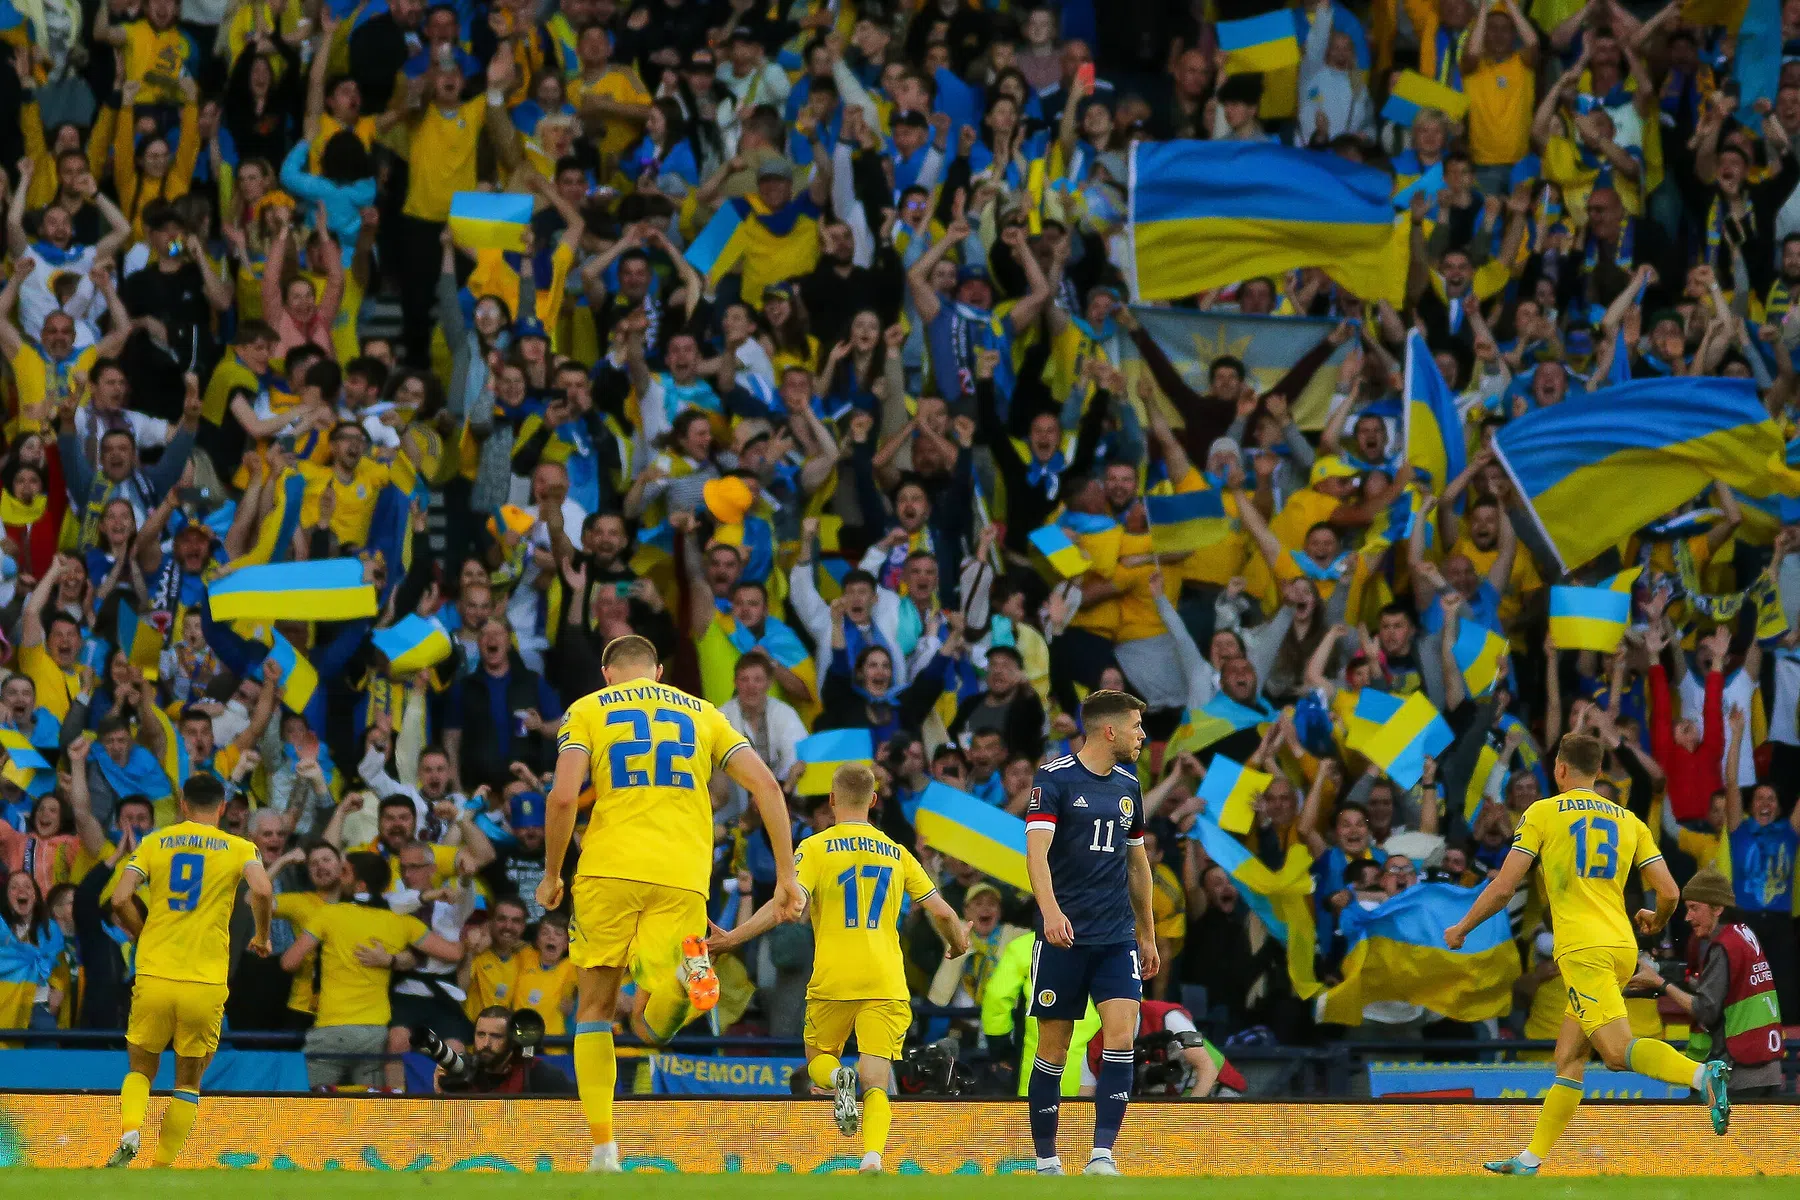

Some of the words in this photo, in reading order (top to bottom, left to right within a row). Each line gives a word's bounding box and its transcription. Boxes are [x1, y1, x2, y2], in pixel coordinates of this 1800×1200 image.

[598, 687, 702, 712] MATVIYENKO
[605, 708, 695, 790] 22
[1557, 799, 1625, 818] ZABARNYI
[824, 836, 901, 861] ZINCHENKO
[1089, 818, 1114, 852] 11
[1568, 815, 1619, 880] 13
[167, 852, 205, 911] 9
[837, 864, 893, 929] 17
